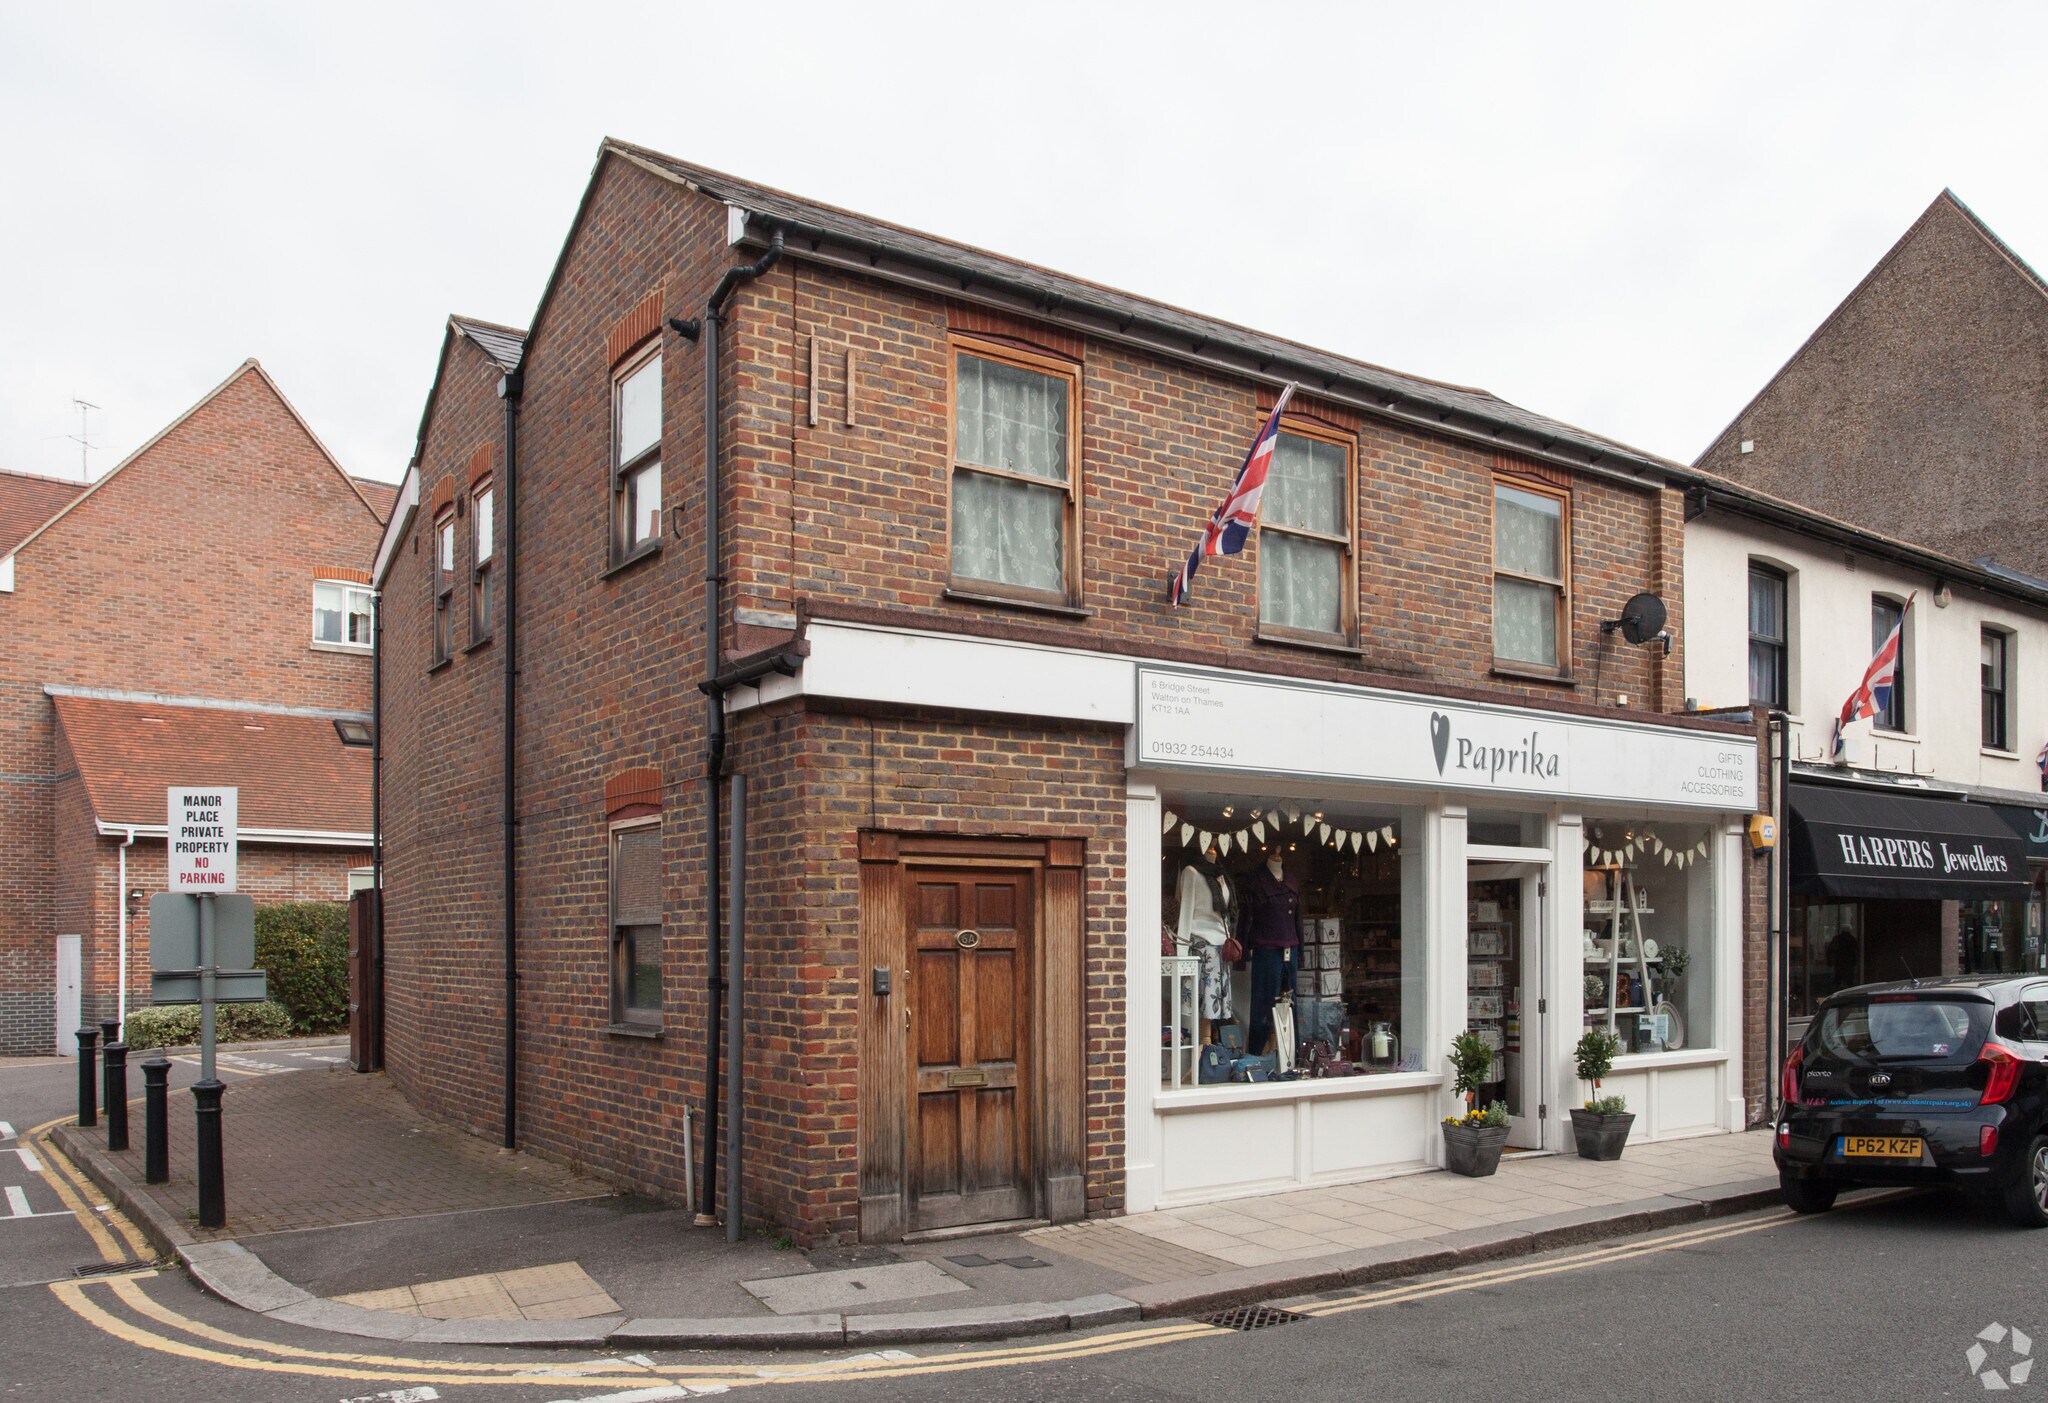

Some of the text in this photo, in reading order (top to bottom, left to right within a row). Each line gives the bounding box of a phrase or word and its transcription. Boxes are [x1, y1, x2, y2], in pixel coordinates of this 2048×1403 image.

[1151, 680, 1210, 694] 6 Bridge Street
[1151, 692, 1224, 708] Walton on Thames
[1151, 704, 1191, 716] KT12 1AA
[1152, 741, 1234, 759] 01932 254434
[1455, 731, 1560, 784] Paprika
[1717, 752, 1744, 766] GIFTS
[1697, 766, 1744, 782] CLOTHING
[1680, 781, 1744, 798] ACCESSORIES
[183, 795, 222, 807] MANOR
[186, 811, 219, 822] PLACE
[181, 826, 224, 838] PRIVATE
[175, 842, 229, 853] PROPERTY
[1837, 833, 2008, 874] HARPERS Jewellers
[194, 857, 209, 868] NO
[180, 872, 225, 884] PARKING
[961, 933, 975, 944] 6A
[1852, 1098, 1873, 1106] Repairs
[1846, 1138, 1920, 1154] LP62 KZF
